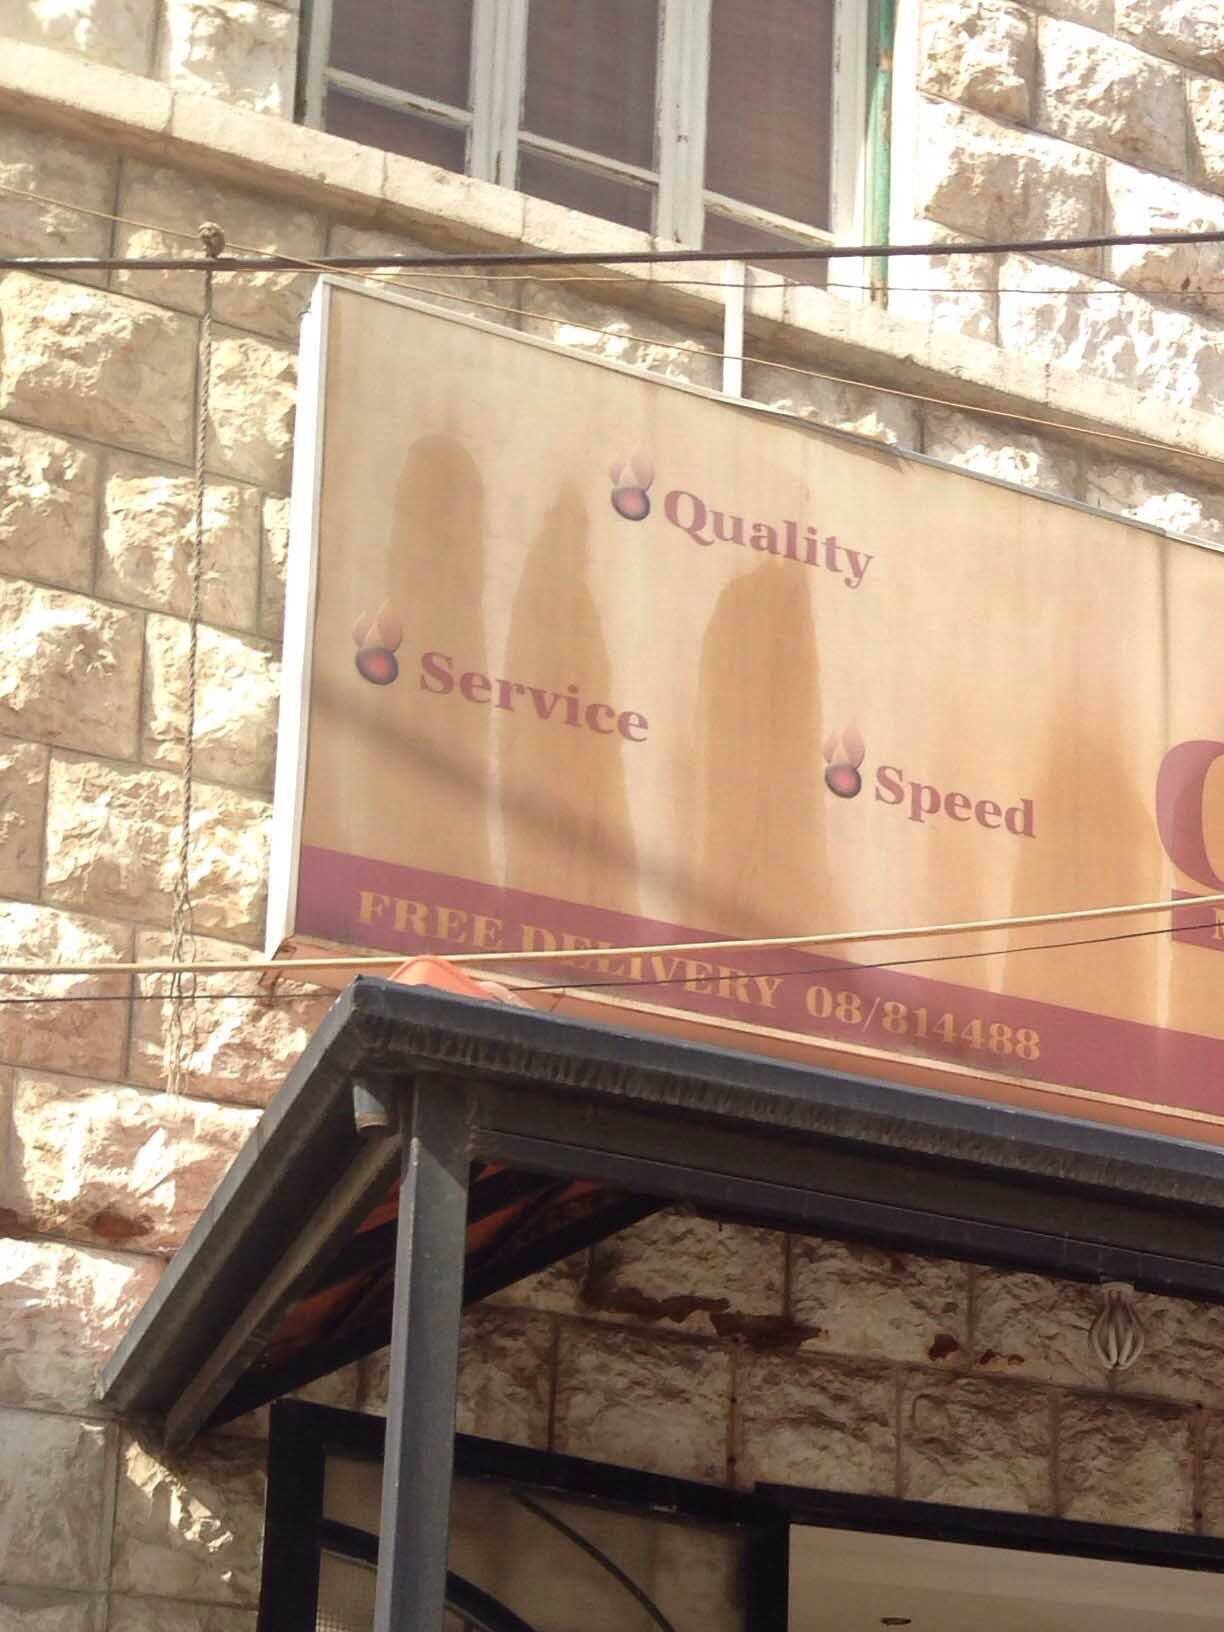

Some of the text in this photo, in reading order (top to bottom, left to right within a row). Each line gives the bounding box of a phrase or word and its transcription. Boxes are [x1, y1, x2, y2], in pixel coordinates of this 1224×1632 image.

[664, 489, 875, 590] Quality
[419, 650, 649, 743] Service
[874, 765, 1037, 839] Speed
[358, 891, 1042, 1062] FREE DELIVERY 08/814488
